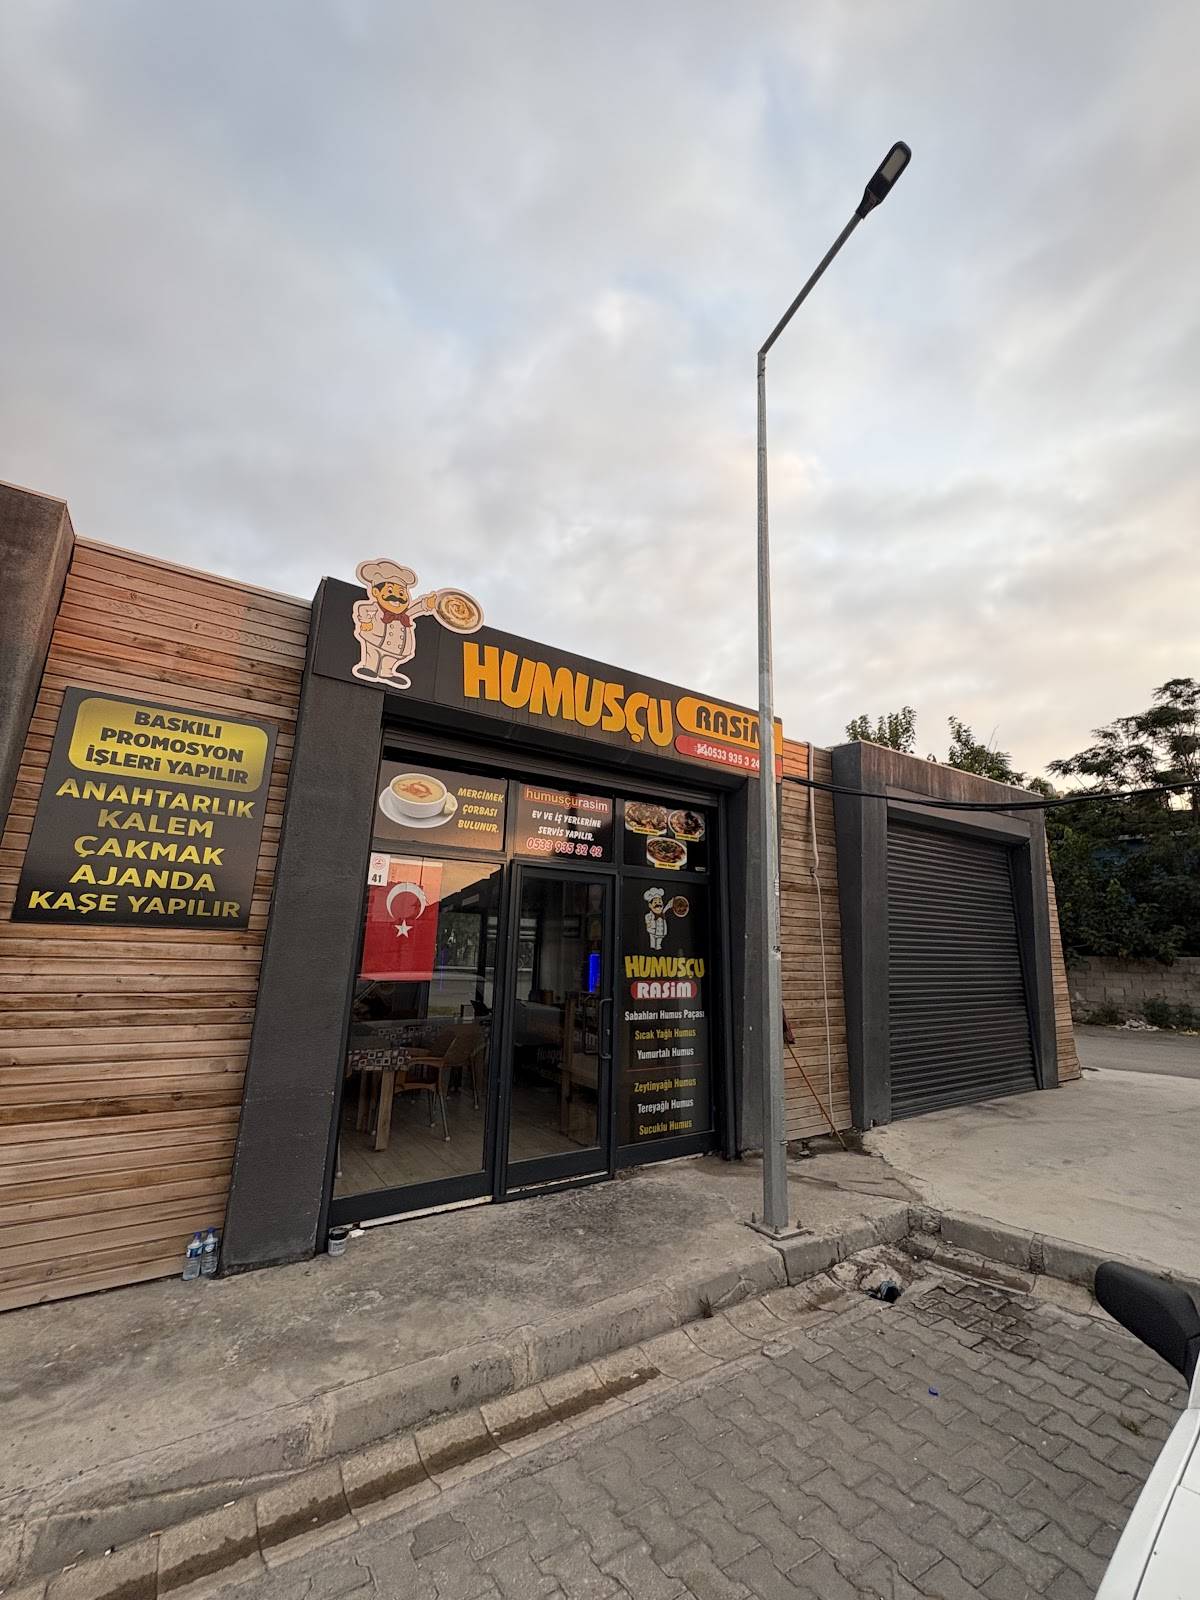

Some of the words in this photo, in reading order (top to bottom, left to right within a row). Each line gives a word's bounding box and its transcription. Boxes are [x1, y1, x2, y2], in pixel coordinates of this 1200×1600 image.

[463, 641, 673, 746] HUMUSÇU
[134, 711, 222, 738] BASKILI
[100, 727, 243, 762] PROMOSYON
[706, 746, 727, 760] 0533
[728, 752, 742, 764] 935
[167, 759, 249, 784] YAPILIR
[56, 778, 255, 818] ANAHTARLIK
[458, 787, 505, 803] MERCİMEK
[462, 804, 498, 817] ÇORBASI
[532, 810, 542, 819] EV
[543, 812, 553, 821] VE
[555, 811, 563, 824] İŞ
[564, 815, 602, 828] YERLERİNE
[97, 809, 214, 838] KALEM
[457, 819, 499, 833] BULUNUR.
[537, 826, 564, 837] SERVİS
[565, 828, 595, 841] YAPILIR.
[74, 836, 225, 866] ÇAKMAK
[526, 837, 553, 850] 0533
[555, 841, 574, 854] 935
[575, 844, 588, 856] 32
[589, 845, 603, 858] 42
[69, 864, 216, 892] AJANDA
[372, 873, 382, 883] 41
[28, 890, 118, 914] KAŞE
[127, 896, 240, 918] YAPILIR
[624, 955, 705, 979] HUMUSÇU
[624, 1010, 658, 1021] Sabahları
[660, 1009, 682, 1020] Humus
[683, 1009, 705, 1020] Paçası
[634, 1030, 654, 1040] Sıcak
[656, 1028, 672, 1040] Yağlı
[674, 1028, 696, 1037] Humus
[637, 1048, 670, 1060] Yumurtalı
[672, 1047, 694, 1057] Humus
[634, 1079, 672, 1093] Zeytinyağlı
[674, 1078, 696, 1088] Humus
[637, 1101, 669, 1114] Tereyağlı
[671, 1099, 694, 1109] Humus
[639, 1122, 668, 1136] Sucuklu
[669, 1120, 692, 1130] Humus
